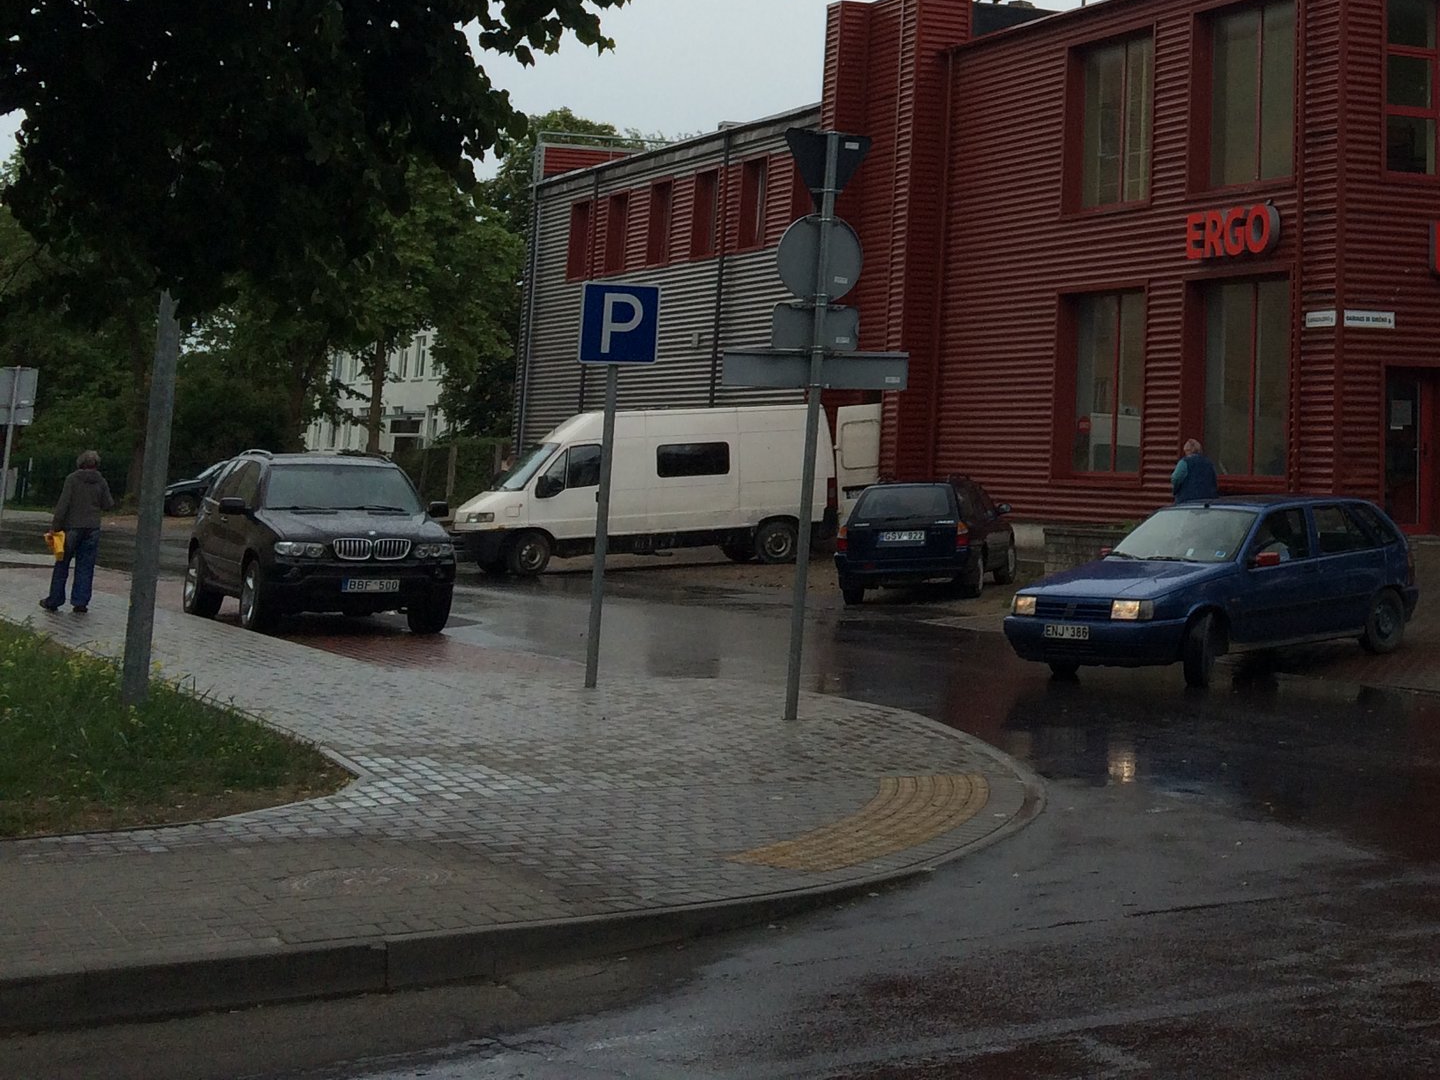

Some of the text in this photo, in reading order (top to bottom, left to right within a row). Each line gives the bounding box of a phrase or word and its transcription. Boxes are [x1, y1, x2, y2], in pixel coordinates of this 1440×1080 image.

[1186, 203, 1280, 260] ERGO
[600, 292, 644, 354] P
[1046, 625, 1065, 637] ENJ
